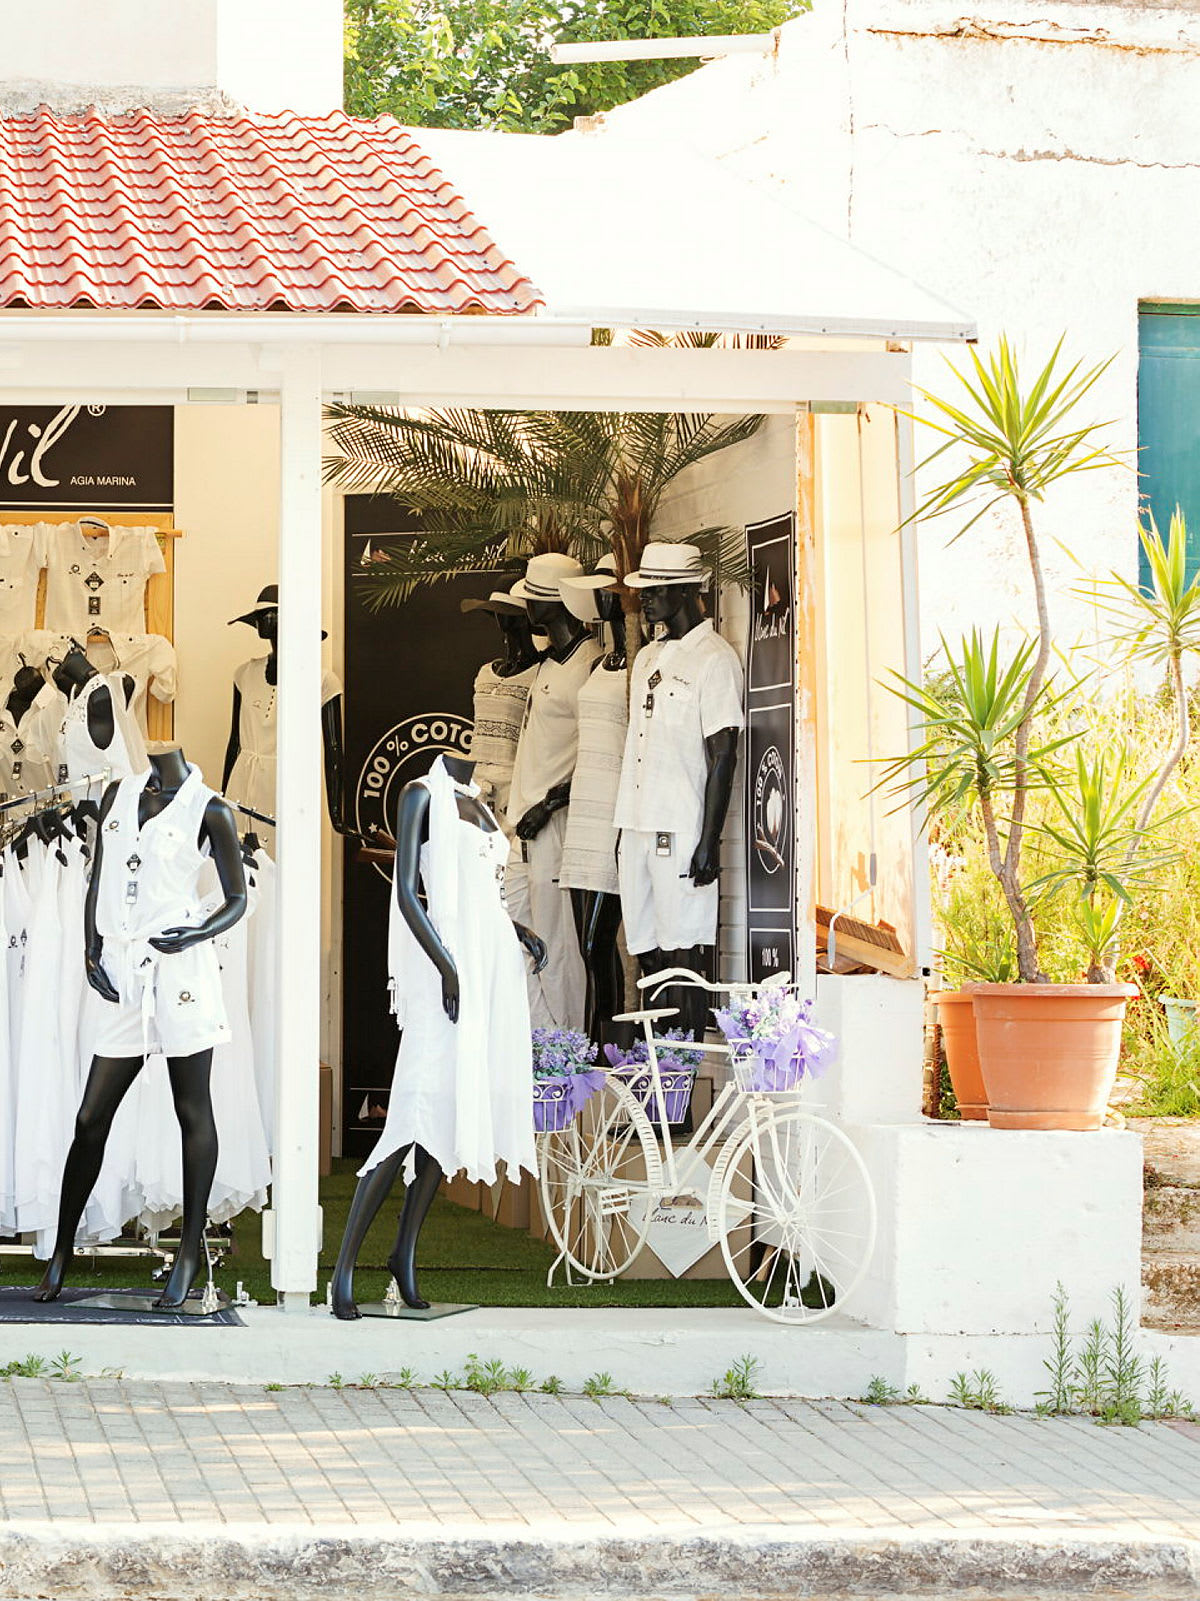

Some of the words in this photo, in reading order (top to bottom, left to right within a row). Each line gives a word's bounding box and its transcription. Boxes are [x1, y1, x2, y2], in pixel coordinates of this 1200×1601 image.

[70, 475, 95, 486] AGIA
[96, 475, 137, 487] MARINA
[364, 756, 391, 798] 100
[386, 735, 409, 757] %
[411, 721, 475, 750] COTO
